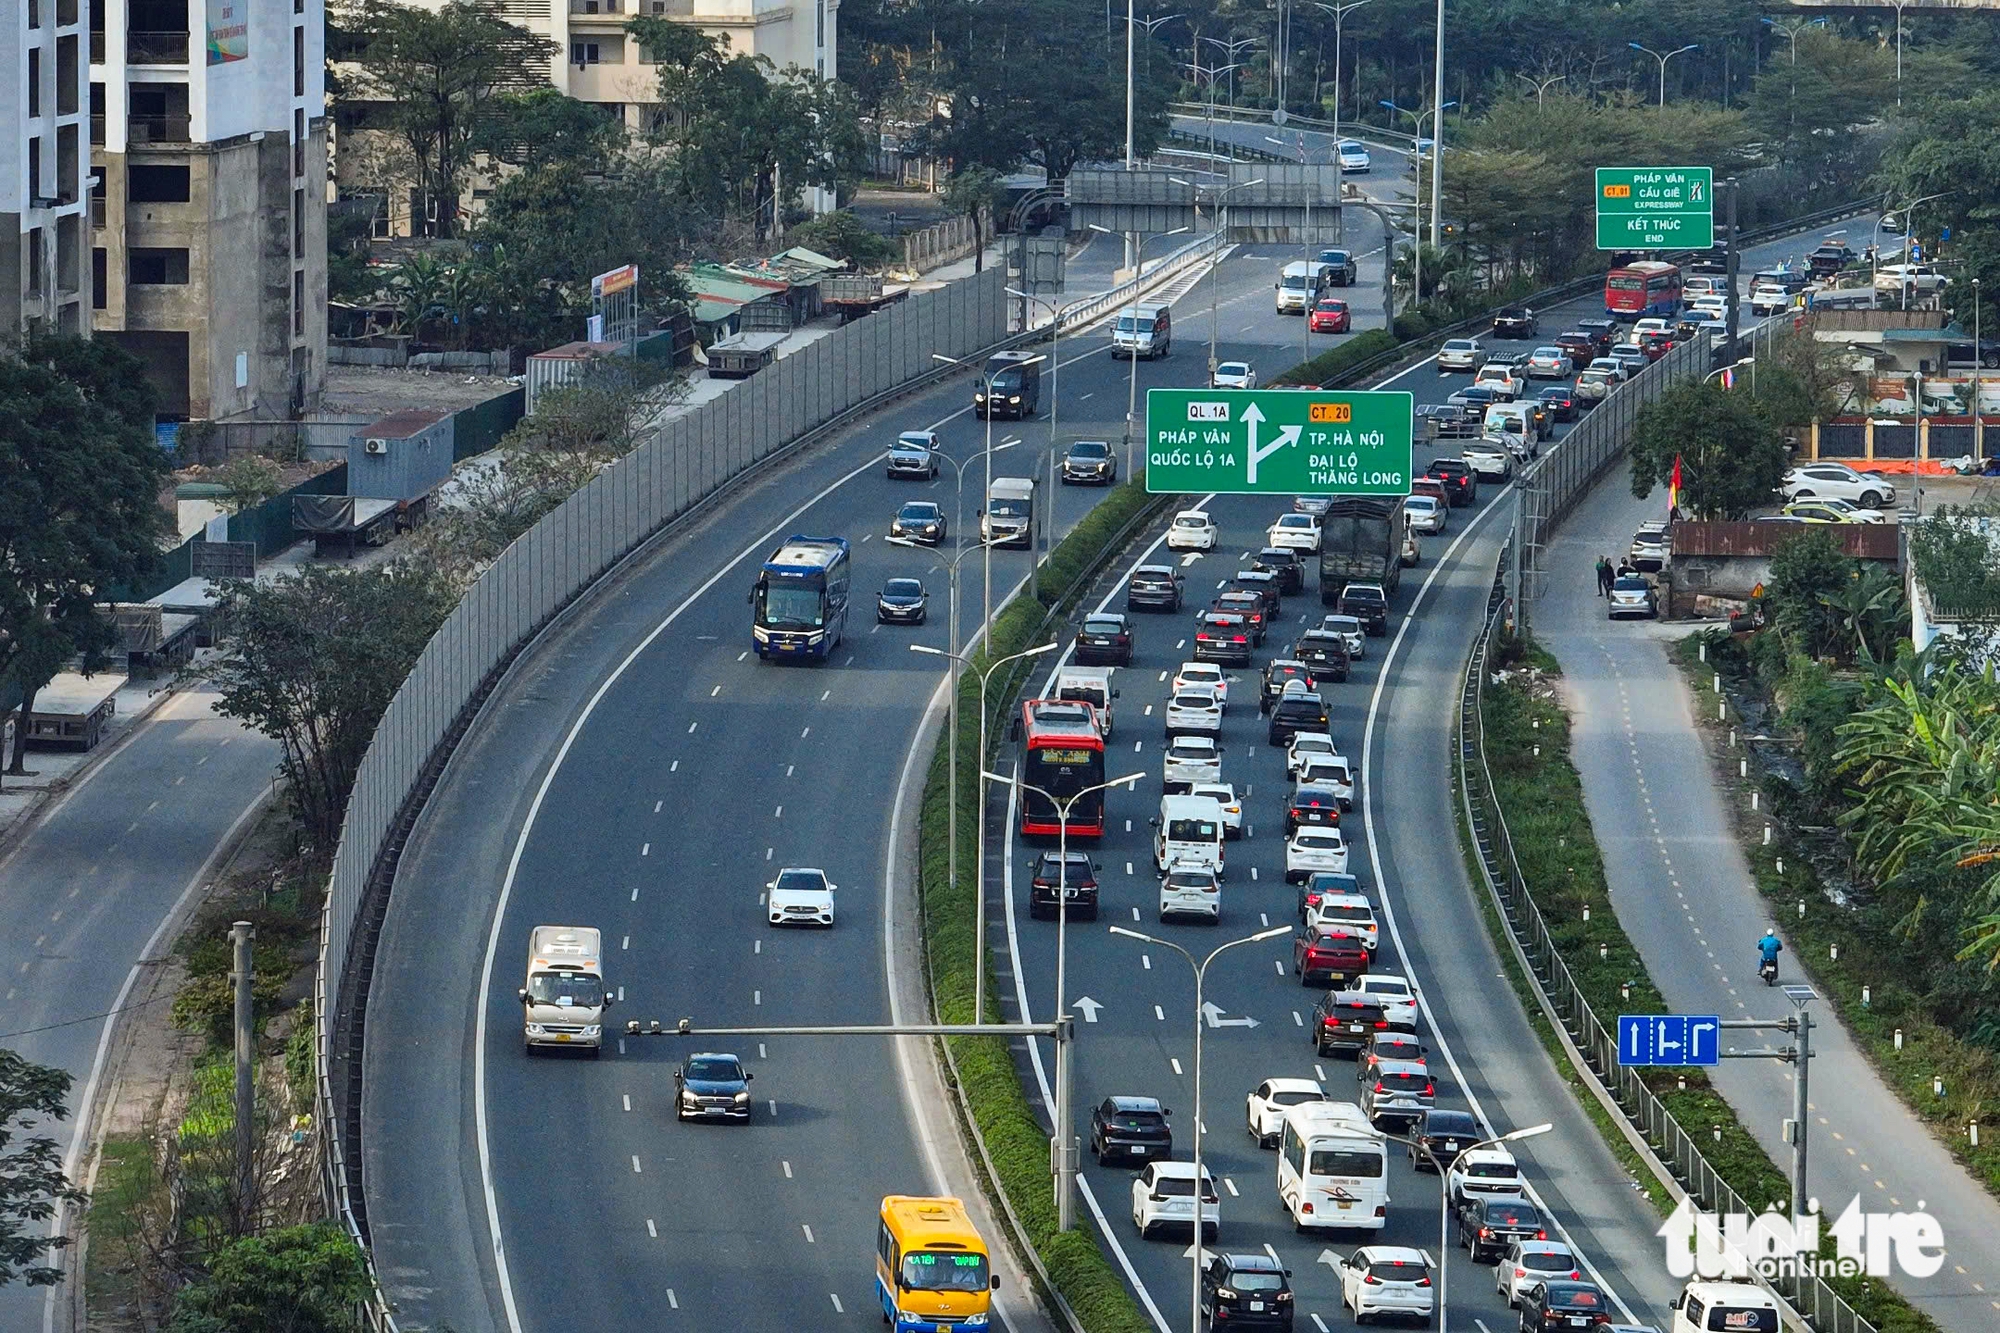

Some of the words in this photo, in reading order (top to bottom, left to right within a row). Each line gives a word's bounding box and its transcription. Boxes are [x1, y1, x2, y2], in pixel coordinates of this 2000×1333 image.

[1633, 172, 1661, 183] PHÁP
[1606, 187, 1628, 196] CT.01
[1634, 201, 1684, 209] EXPRESSWAY
[1627, 216, 1649, 231] KẾT
[1652, 217, 1681, 230] THÚC
[1645, 234, 1664, 243] END
[1311, 407, 1349, 419] CT.20
[1158, 428, 1197, 444] PHÁP
[1202, 428, 1231, 444] VÂN
[1359, 430, 1384, 449] NỘI
[1151, 449, 1190, 466] QUỐC
[1195, 450, 1214, 470] LỘ
[1219, 453, 1236, 467] 1A
[1308, 454, 1334, 469] ĐẠI
[1339, 452, 1358, 471] LỘ
[1309, 471, 1358, 485] THĂNG
[1363, 471, 1402, 485] LONG
